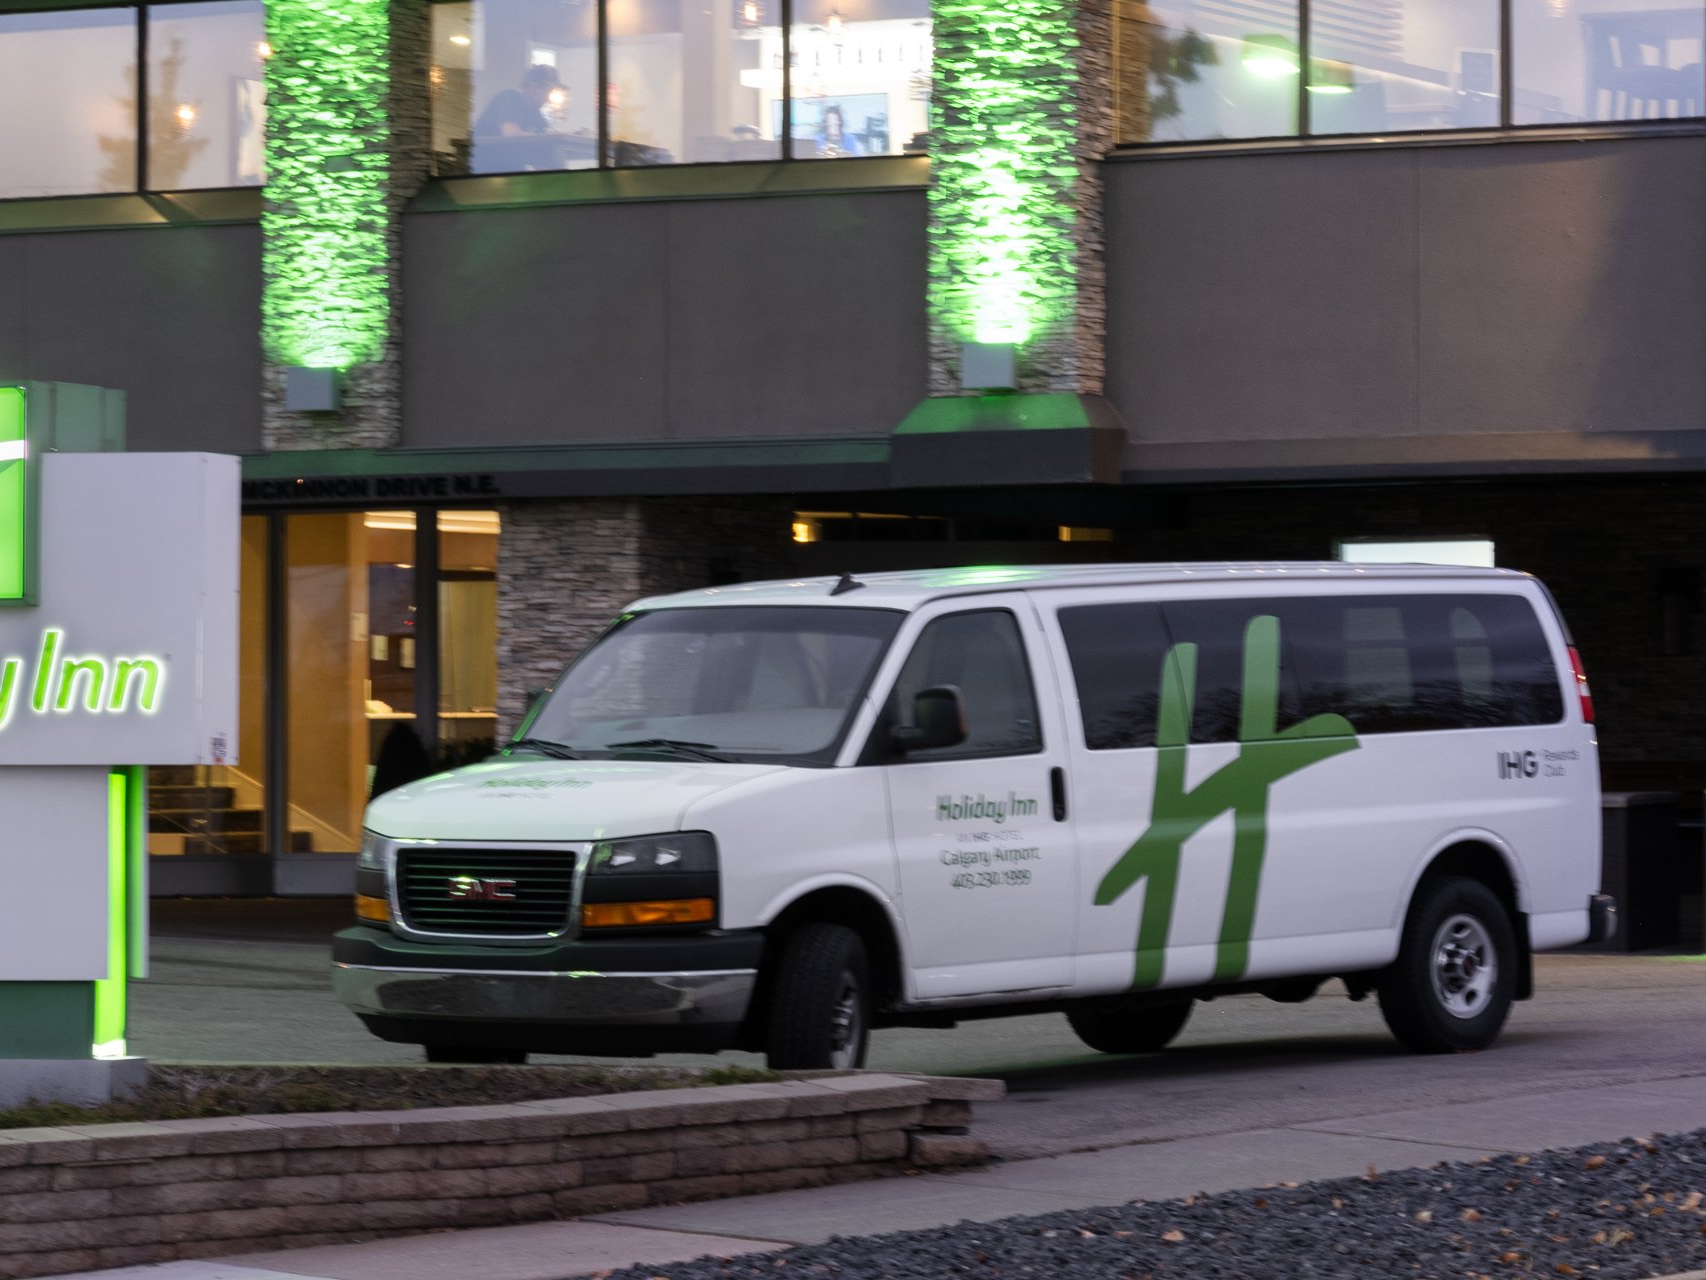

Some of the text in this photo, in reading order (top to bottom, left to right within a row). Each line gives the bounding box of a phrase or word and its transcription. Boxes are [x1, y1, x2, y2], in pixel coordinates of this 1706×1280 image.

[375, 476, 449, 496] DRIVE
[31, 628, 163, 714] Inn
[1496, 750, 1539, 780] IHG
[936, 790, 1038, 824] Holiday Inn
[940, 846, 1042, 868] Calgary Airport
[446, 877, 516, 901] GMC
